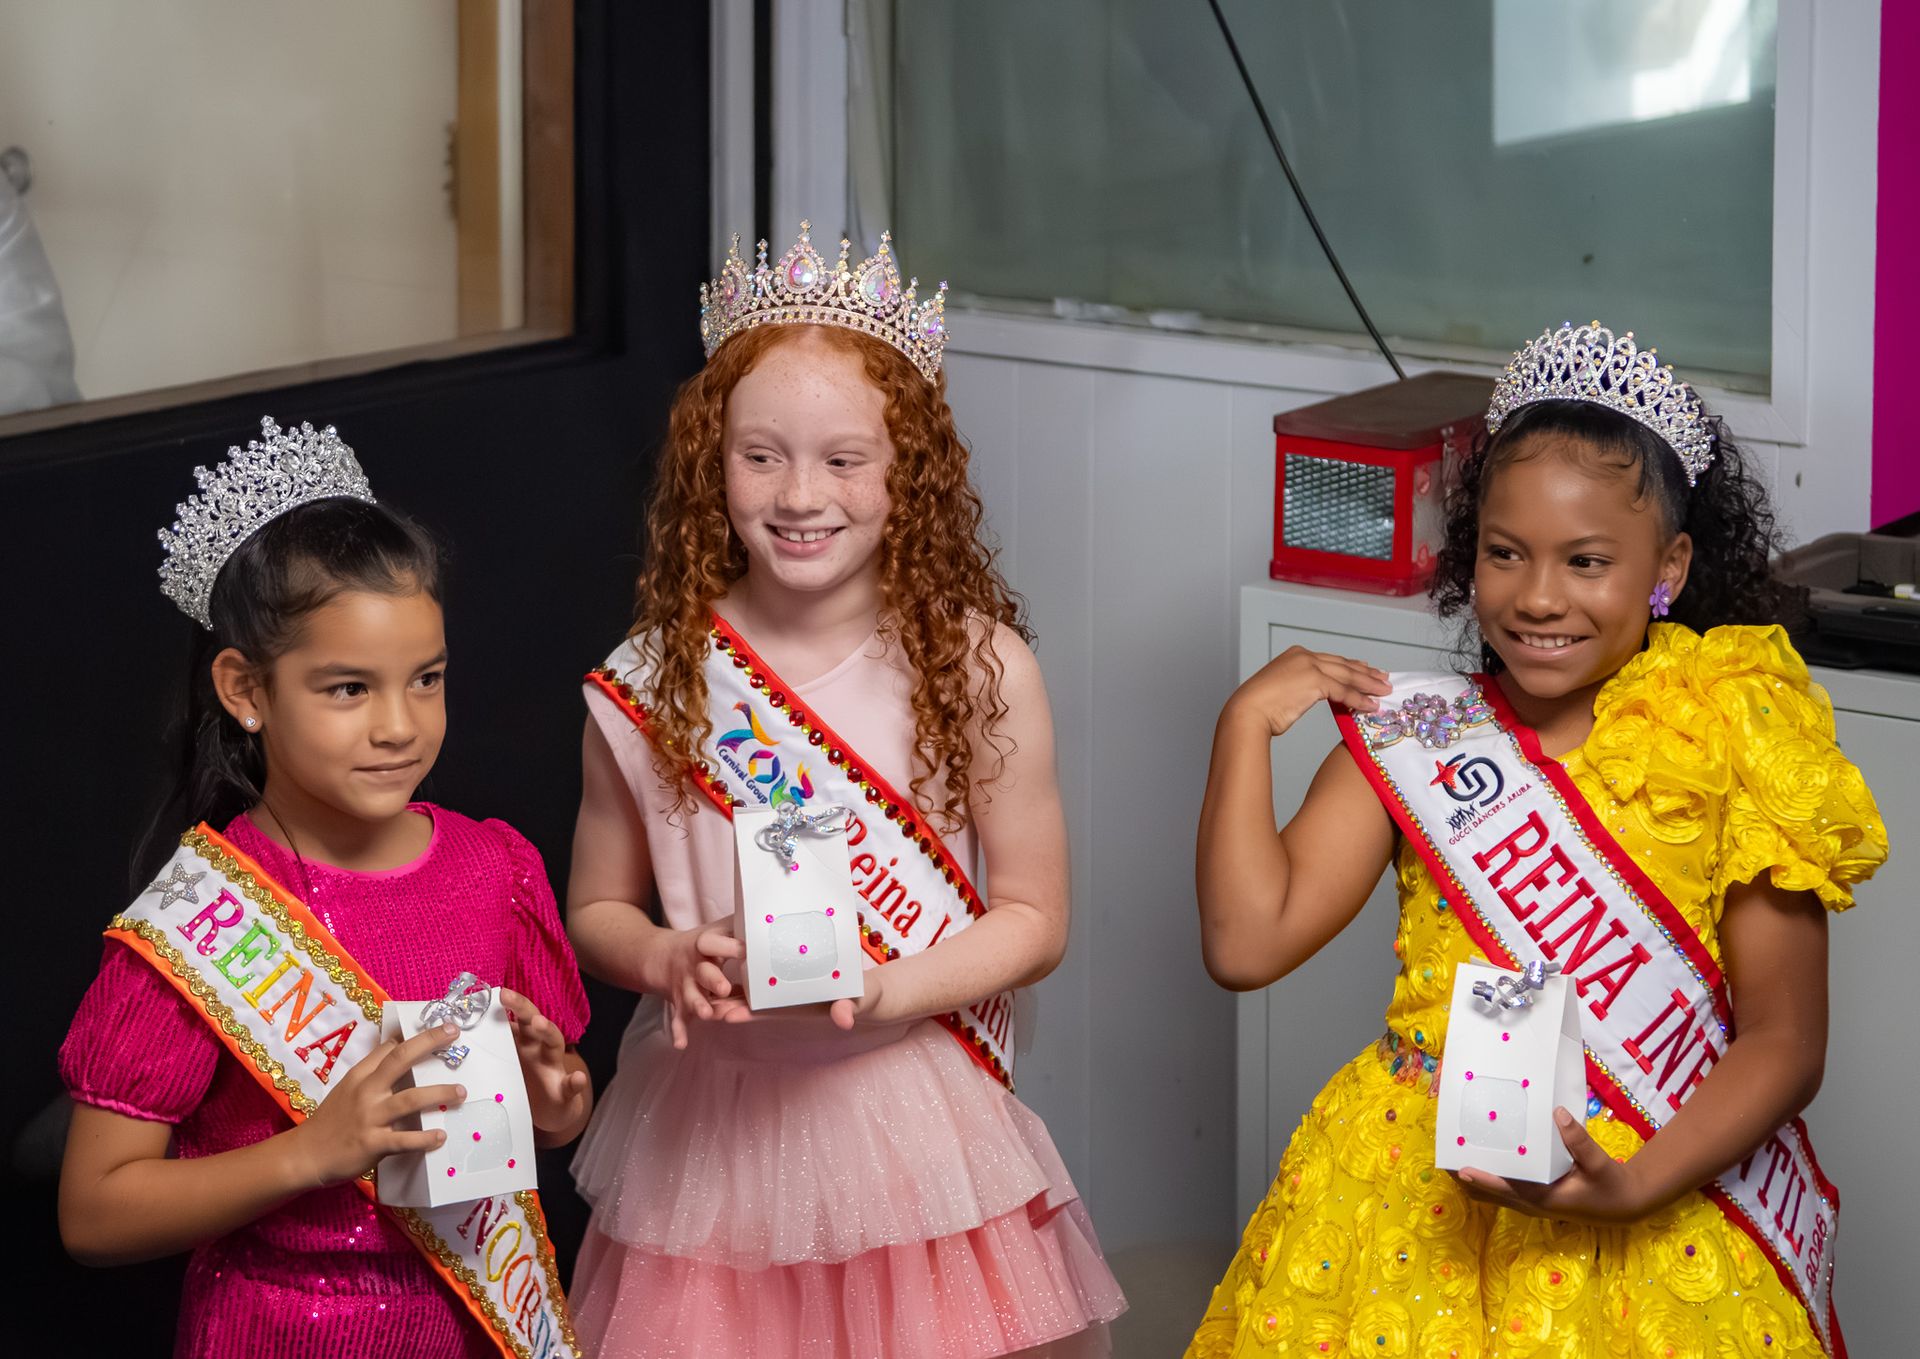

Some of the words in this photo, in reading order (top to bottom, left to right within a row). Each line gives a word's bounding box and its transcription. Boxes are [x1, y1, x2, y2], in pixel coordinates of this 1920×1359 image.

[718, 748, 748, 781] Carnival
[745, 779, 769, 805] Group
[1448, 827, 1473, 846] GUCCI
[1472, 801, 1507, 829] DANCERS
[1506, 783, 1533, 804] ARUBA
[1472, 810, 1653, 1021] REINA
[176, 886, 358, 1085] REINA
